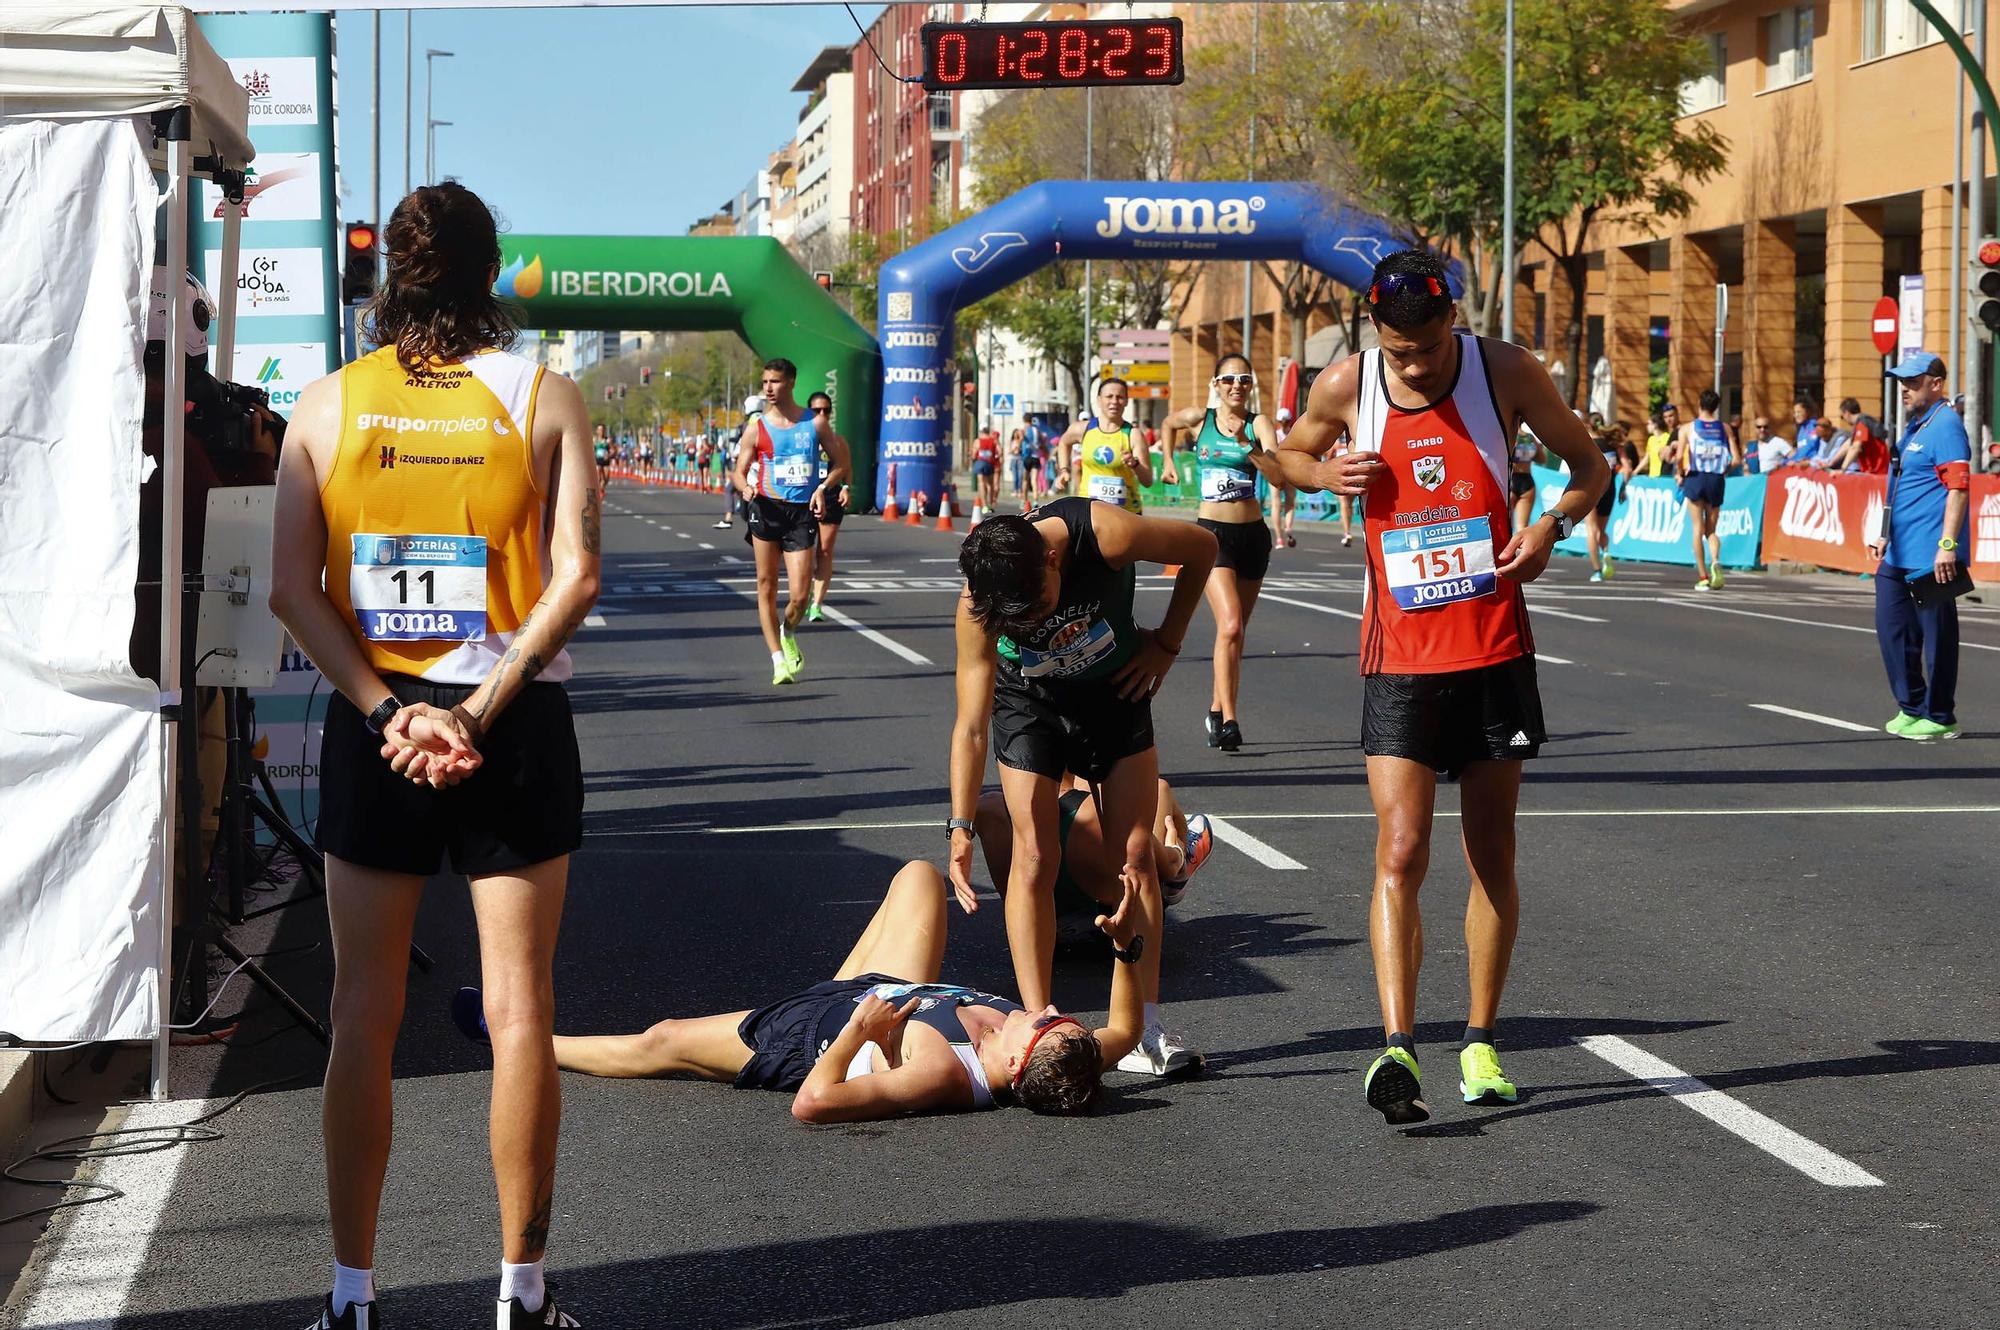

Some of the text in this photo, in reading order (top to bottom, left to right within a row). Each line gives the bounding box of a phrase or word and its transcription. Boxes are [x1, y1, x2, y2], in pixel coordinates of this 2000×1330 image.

[263, 105, 273, 115] DE
[551, 271, 733, 298] IBERDROLA
[1407, 436, 1443, 449] GARBO
[1101, 486, 1116, 496] 98
[1217, 479, 1235, 492] 66
[1395, 505, 1460, 525] madeira
[1424, 524, 1467, 538] LOTERÍAS
[401, 540, 457, 550] LOTERÍAS
[1411, 547, 1467, 580] 151
[390, 570, 434, 604] 11
[1413, 579, 1476, 604] Joma
[374, 612, 457, 636] Joma
